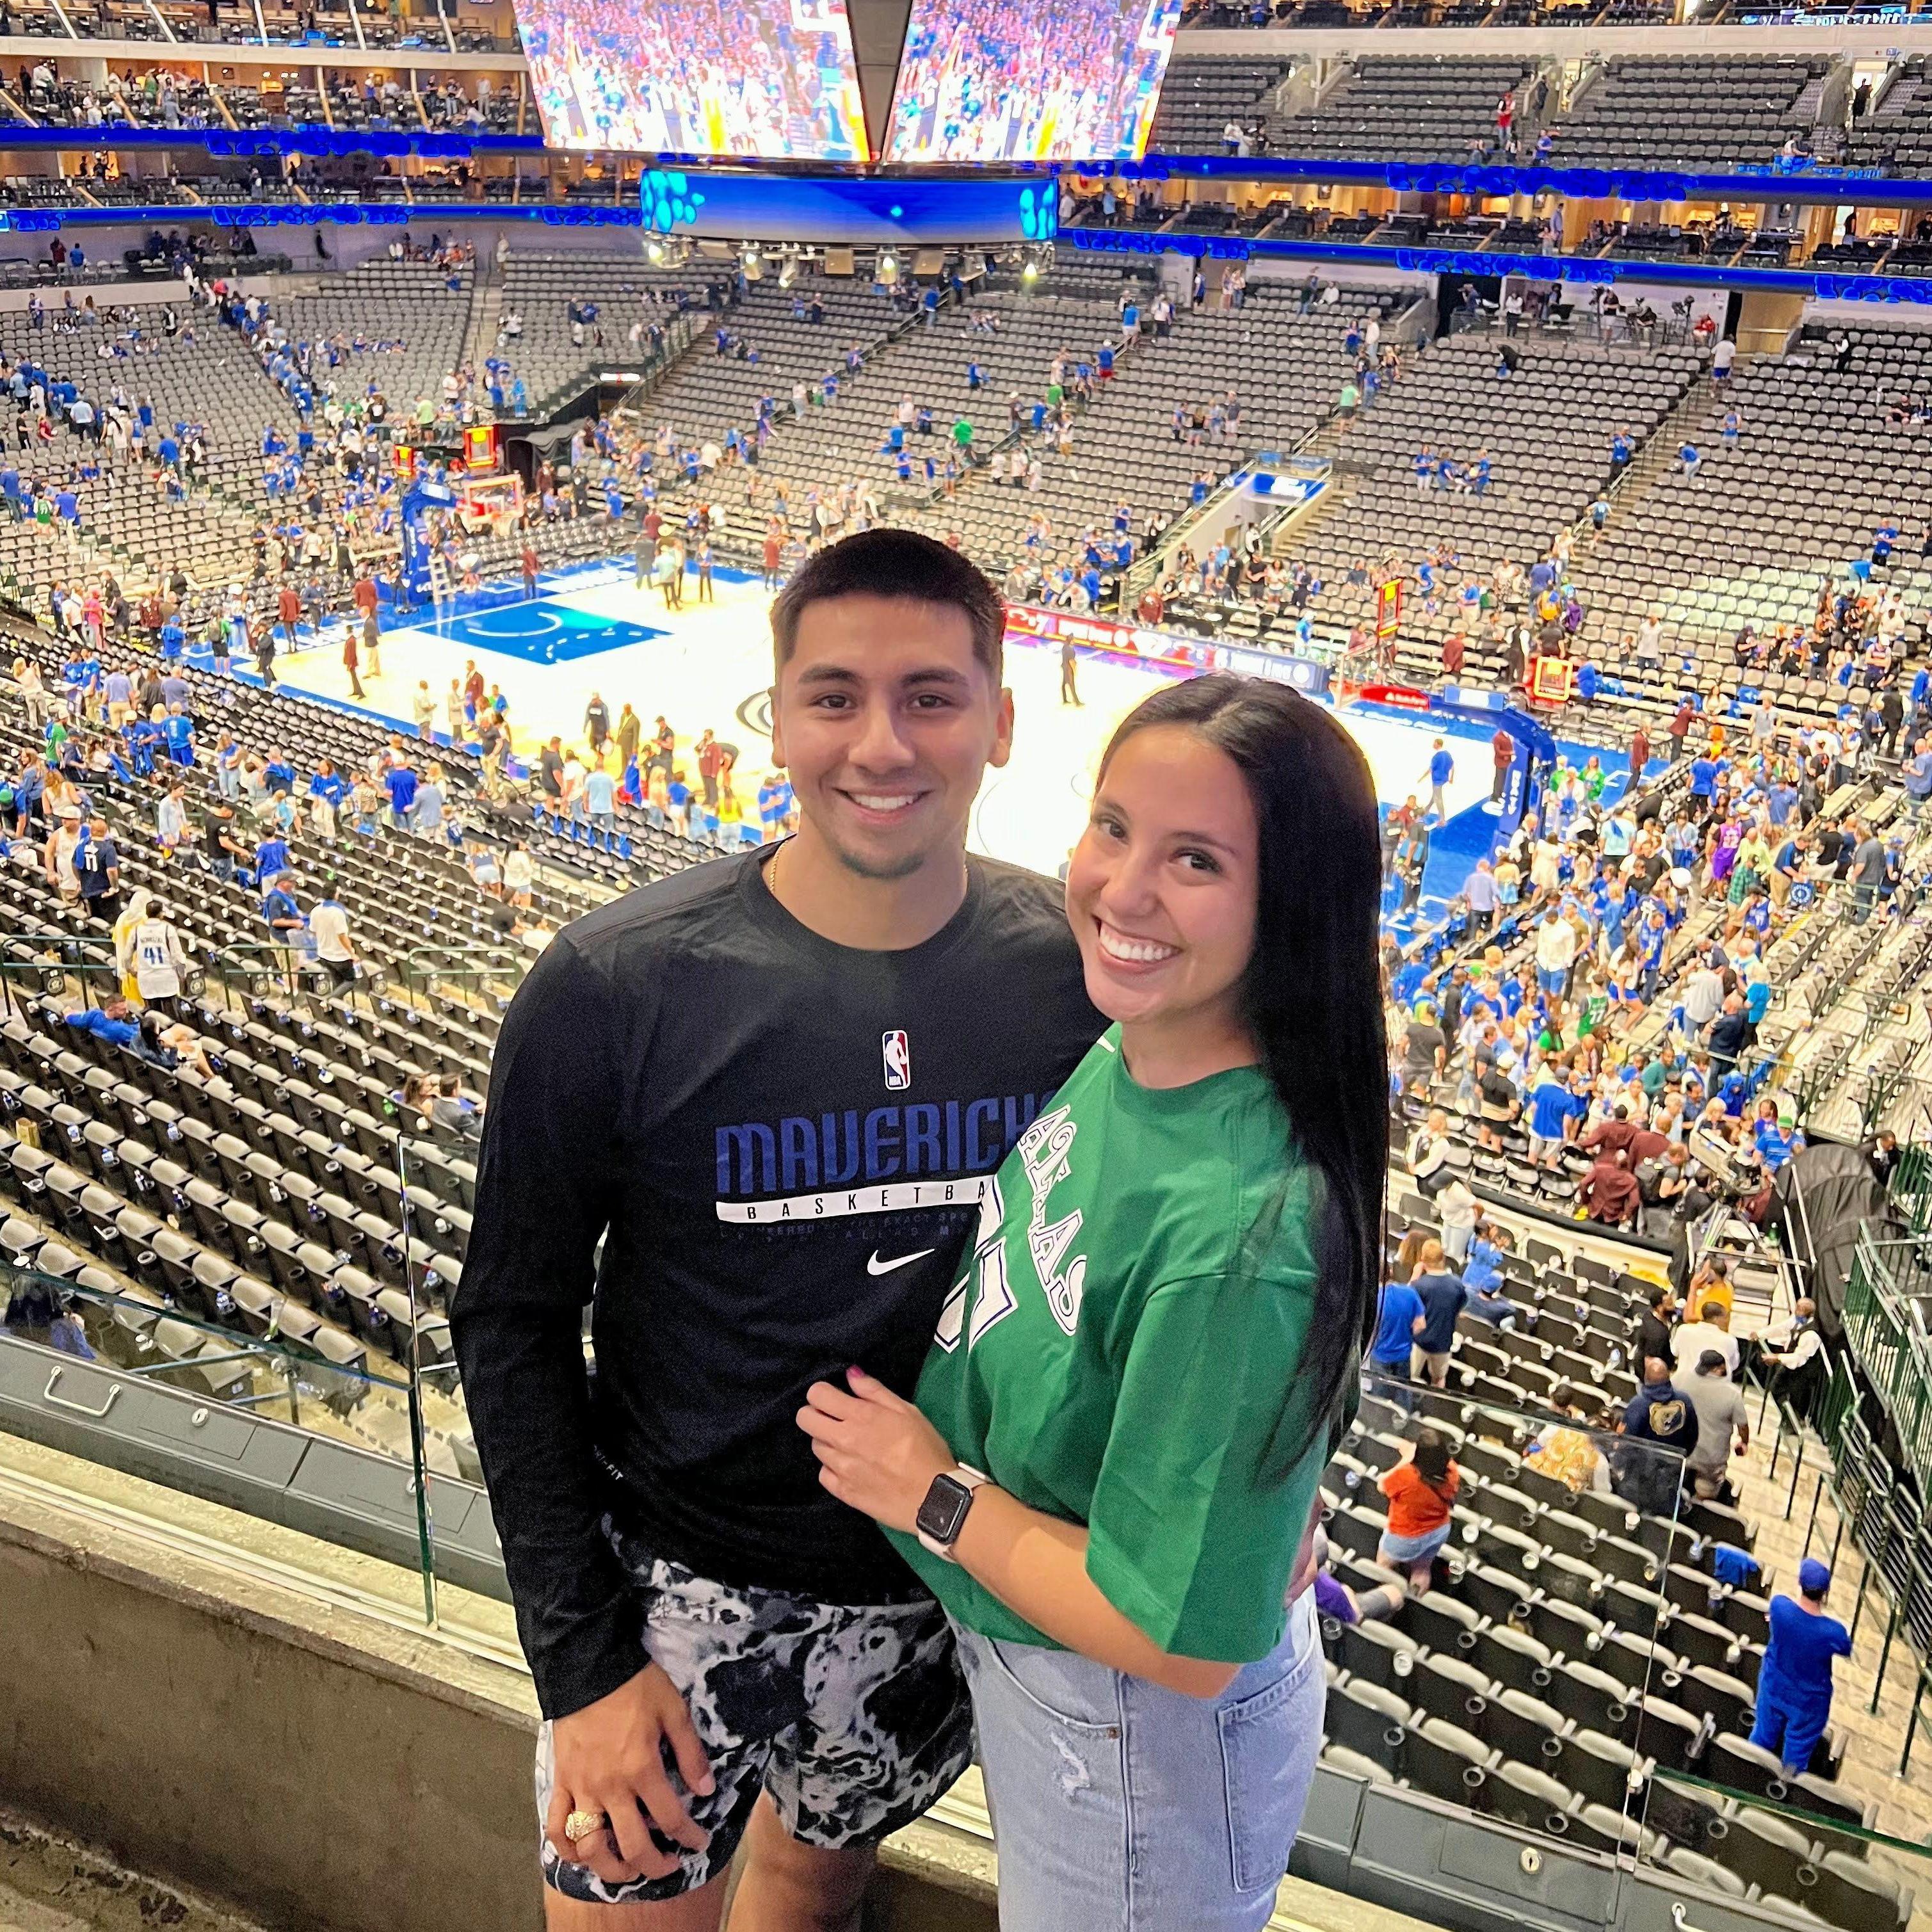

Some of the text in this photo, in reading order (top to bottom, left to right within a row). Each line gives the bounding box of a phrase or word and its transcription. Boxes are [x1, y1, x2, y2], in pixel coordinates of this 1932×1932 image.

[144, 946, 163, 964] 41
[716, 1090, 1059, 1193] MAVERICK
[747, 1181, 985, 1219] BASKETBA
[1017, 1104, 1087, 1337] ALLAS
